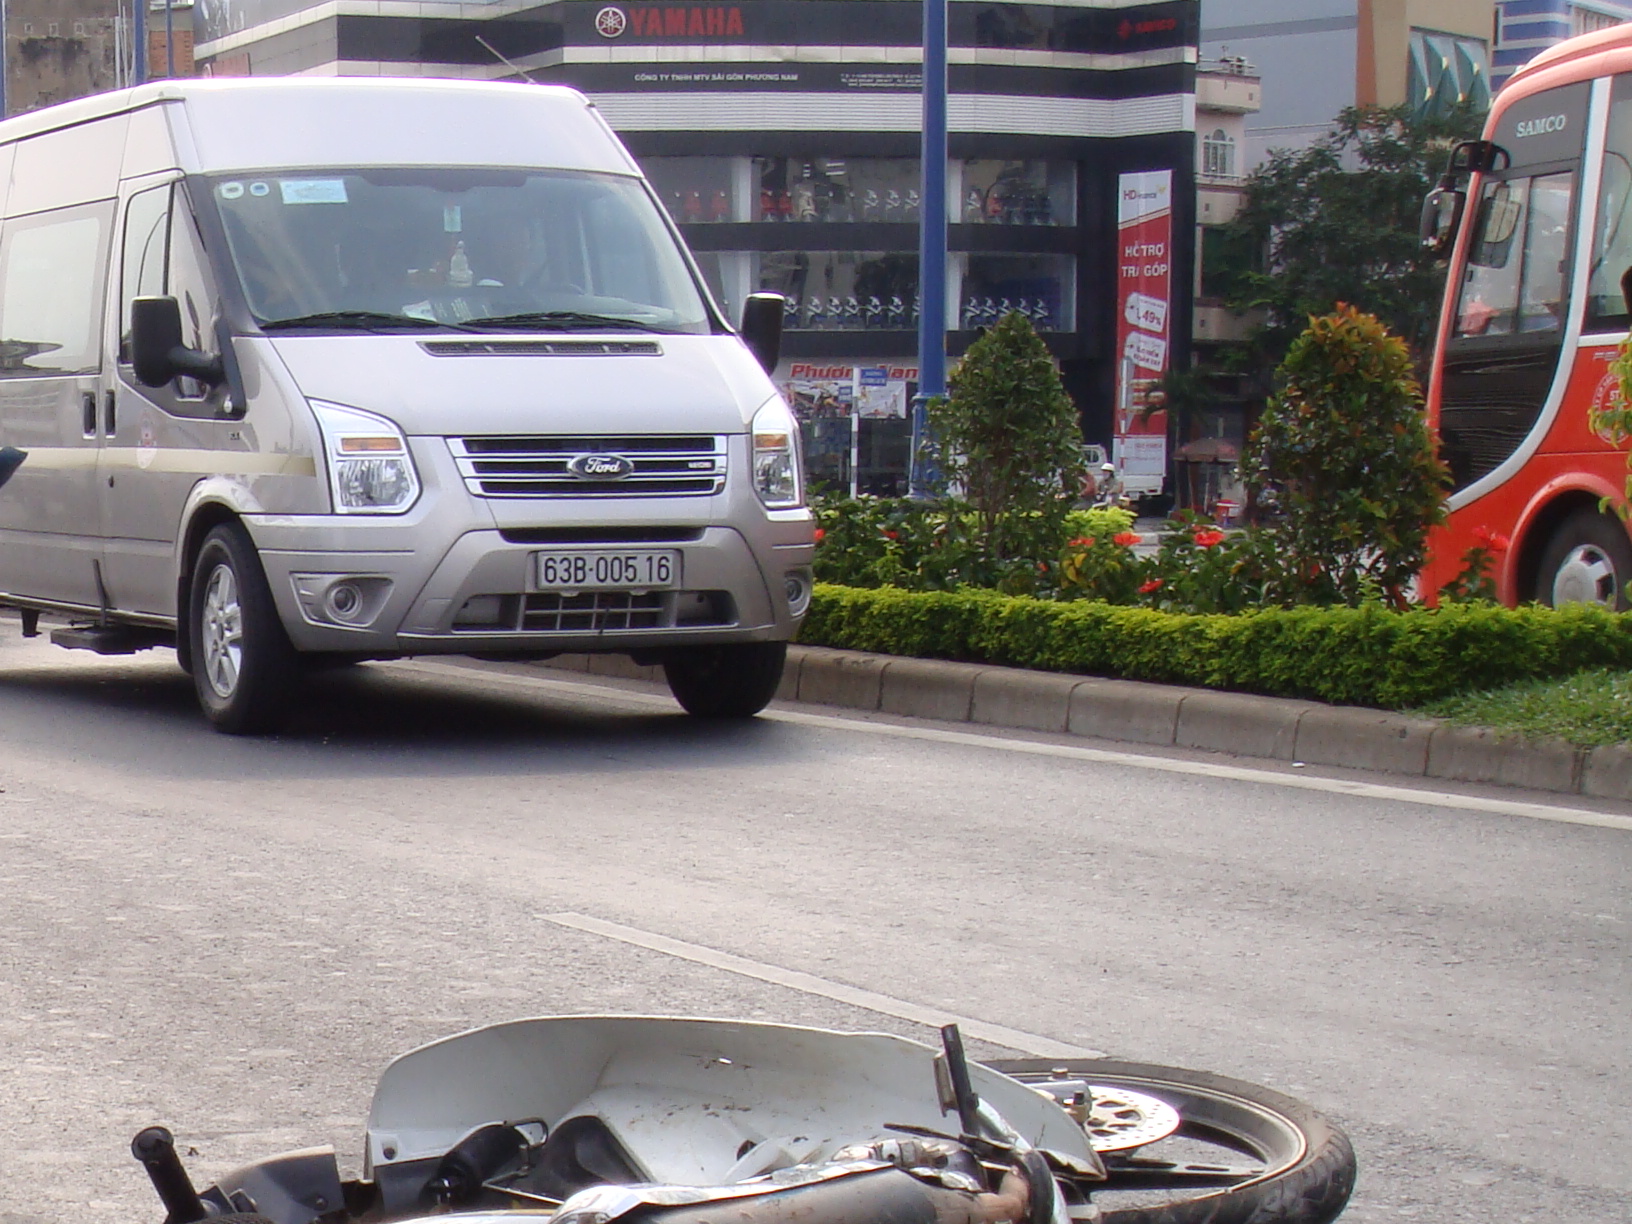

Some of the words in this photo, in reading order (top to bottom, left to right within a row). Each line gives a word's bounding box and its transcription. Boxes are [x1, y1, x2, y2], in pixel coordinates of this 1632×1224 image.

[629, 7, 745, 37] YAMAHA
[659, 73, 669, 82] TY
[781, 73, 799, 82] NAM
[1516, 114, 1566, 138] SAMCO
[1144, 262, 1168, 276] GÓP
[585, 457, 621, 474] Ford
[544, 555, 670, 584] 63B-005.16
